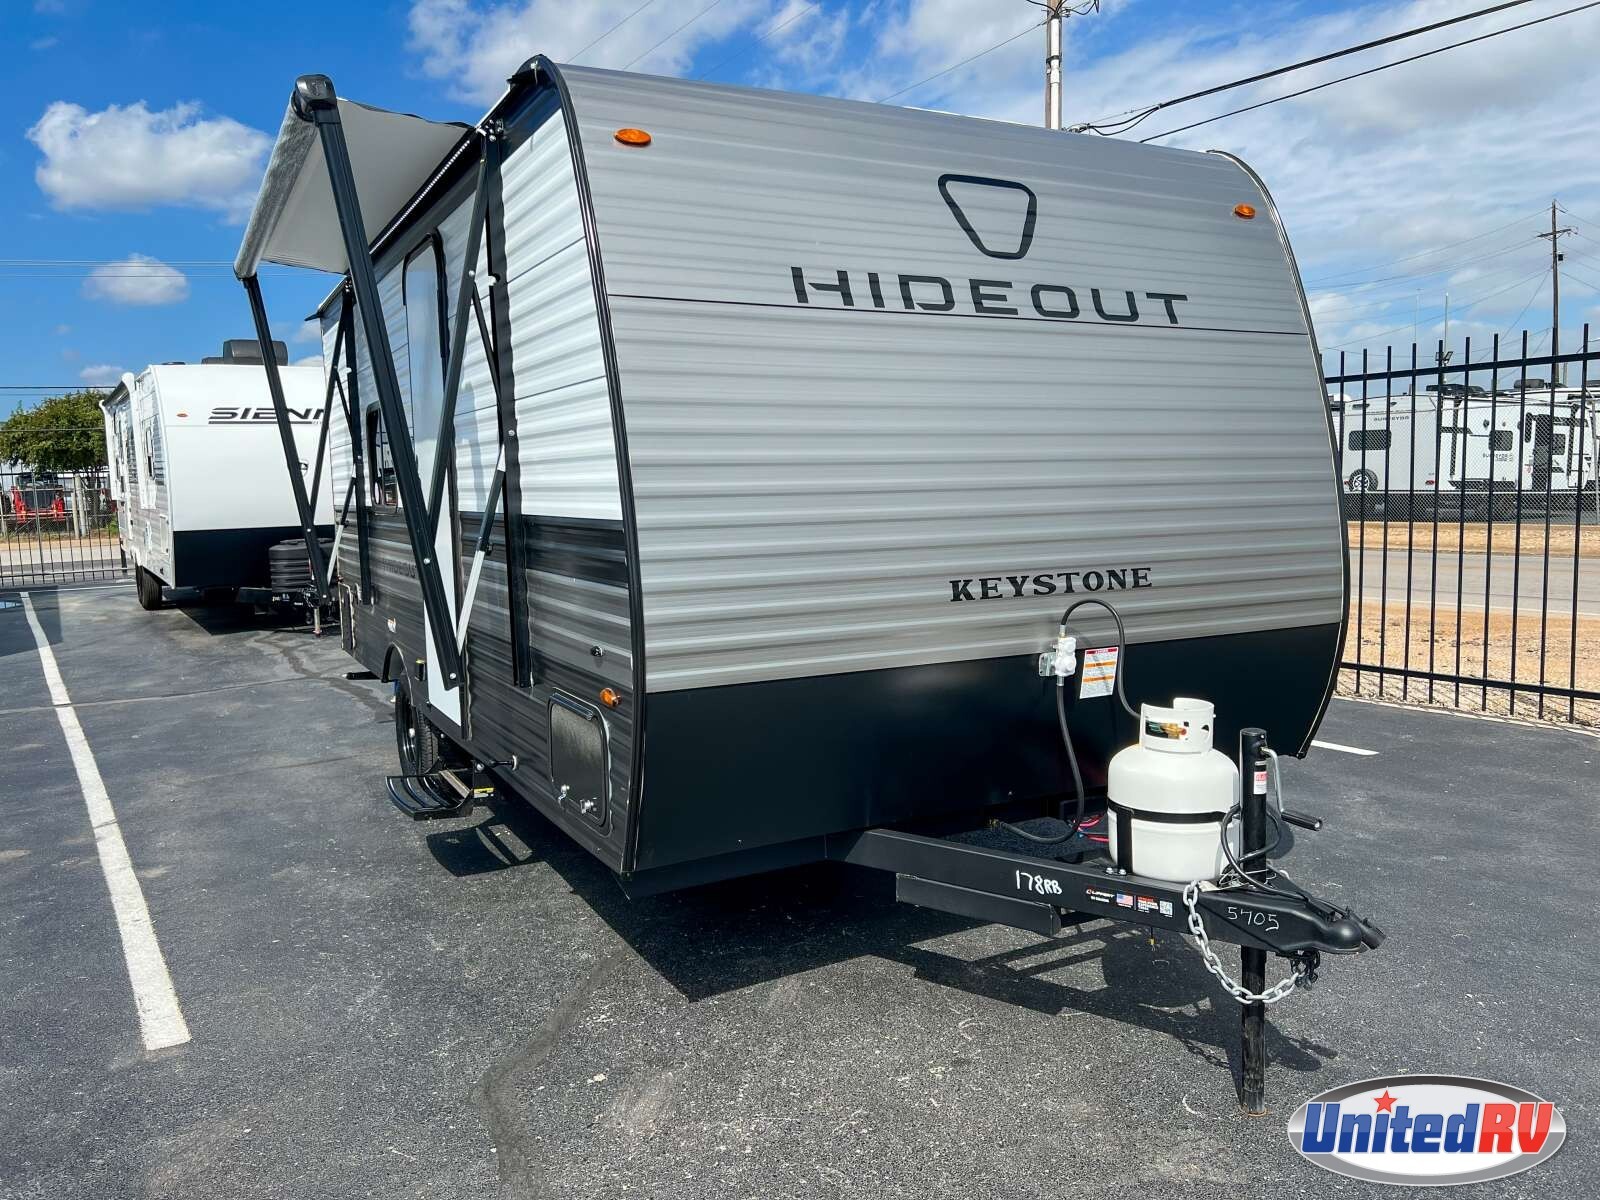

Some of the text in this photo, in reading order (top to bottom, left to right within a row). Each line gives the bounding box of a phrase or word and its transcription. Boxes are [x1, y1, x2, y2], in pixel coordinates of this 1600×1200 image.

[791, 267, 1188, 324] HIDEOUT
[950, 567, 1152, 602] KEYSTONE
[1016, 869, 1062, 895] 178RB
[1227, 906, 1279, 931] 5705
